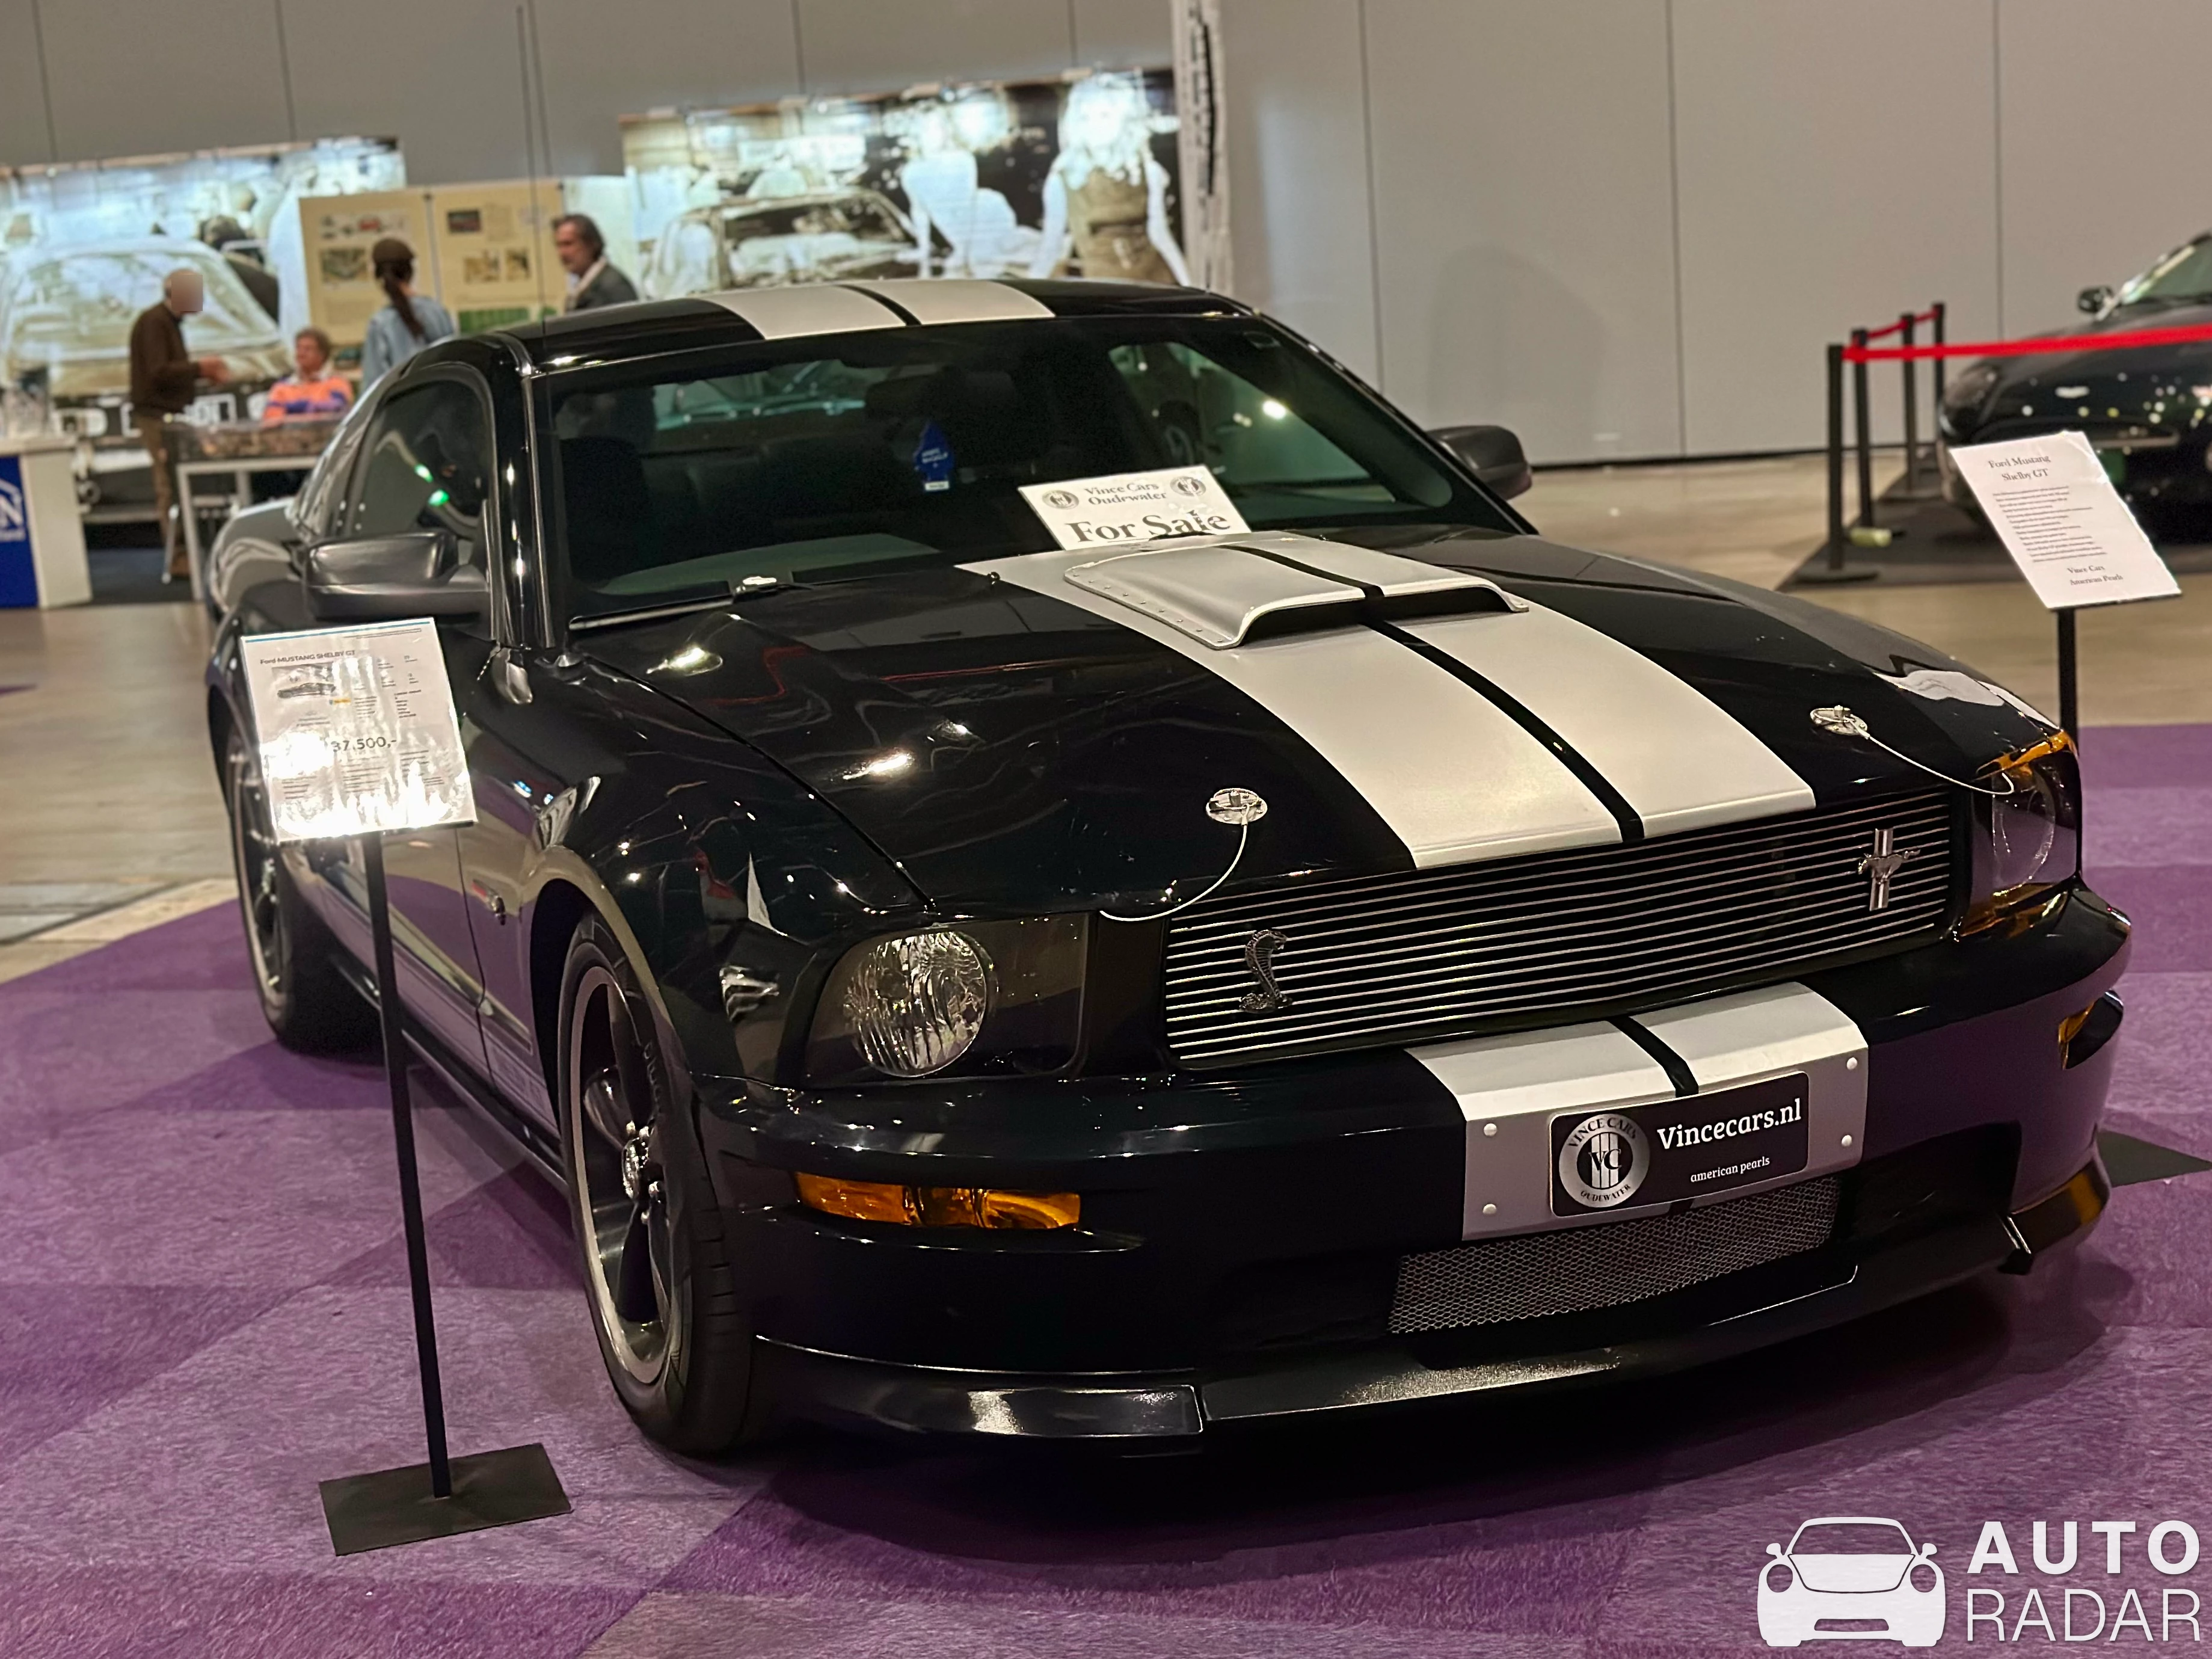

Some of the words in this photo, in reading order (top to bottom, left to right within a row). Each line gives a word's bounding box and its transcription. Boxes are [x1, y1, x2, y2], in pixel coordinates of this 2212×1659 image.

[1988, 459, 2011, 468] Ford
[2012, 456, 2051, 466] Mustang
[2002, 472, 2032, 481] Shelby
[2033, 469, 2048, 477] GT
[1084, 487, 1125, 495] Vince
[1126, 482, 1160, 492] Cars
[1088, 493, 1167, 505] Oudewater
[1065, 521, 1136, 542] For
[1142, 509, 1231, 536] Sale
[277, 654, 316, 663] MUSTANG
[316, 650, 345, 659] SHELBY
[1568, 1118, 1605, 1147] VINCE
[1606, 1117, 1636, 1139] CARS
[1656, 1098, 1802, 1150] Vincecars.nl
[1690, 1165, 1739, 1183] american
[1740, 1156, 1771, 1174] pearls
[1580, 1183, 1631, 1202] OUDEWATER
